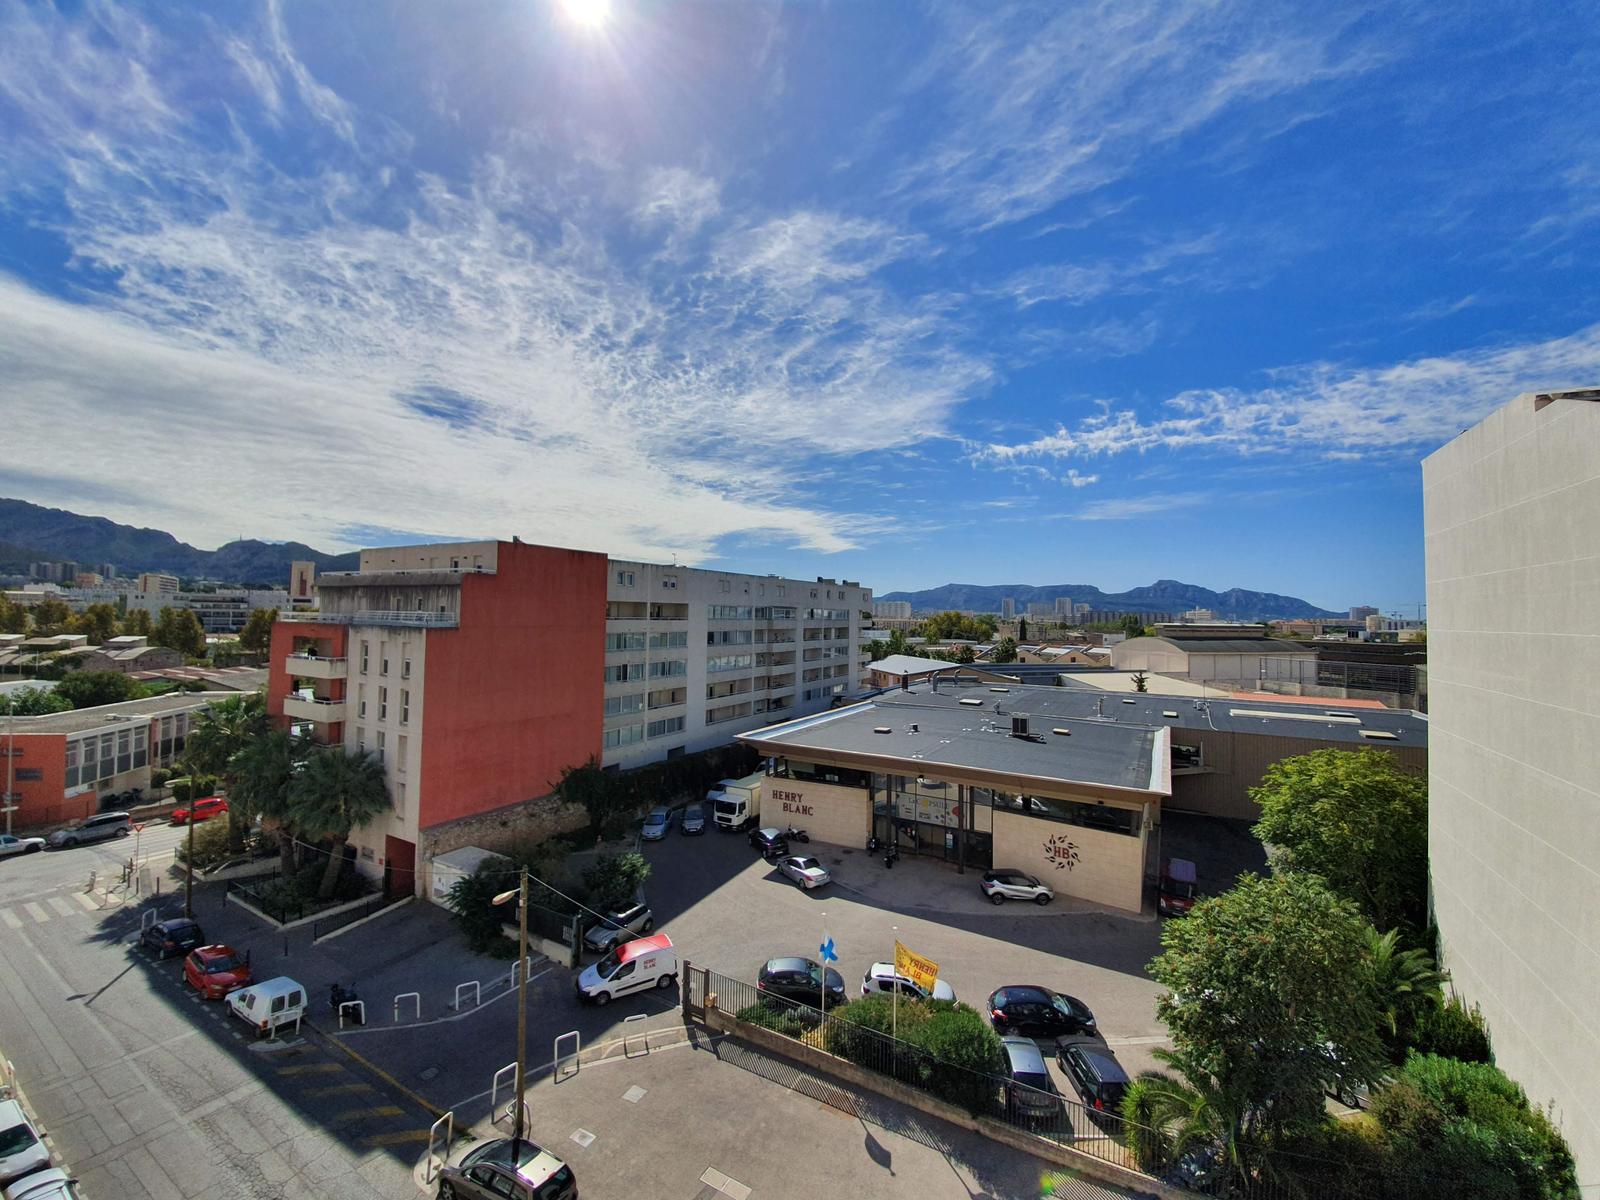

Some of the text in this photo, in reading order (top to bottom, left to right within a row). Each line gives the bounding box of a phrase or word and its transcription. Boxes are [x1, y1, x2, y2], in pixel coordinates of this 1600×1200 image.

[772, 789, 803, 803] HENRY
[783, 802, 814, 816] BLANC
[1053, 846, 1070, 859] HB
